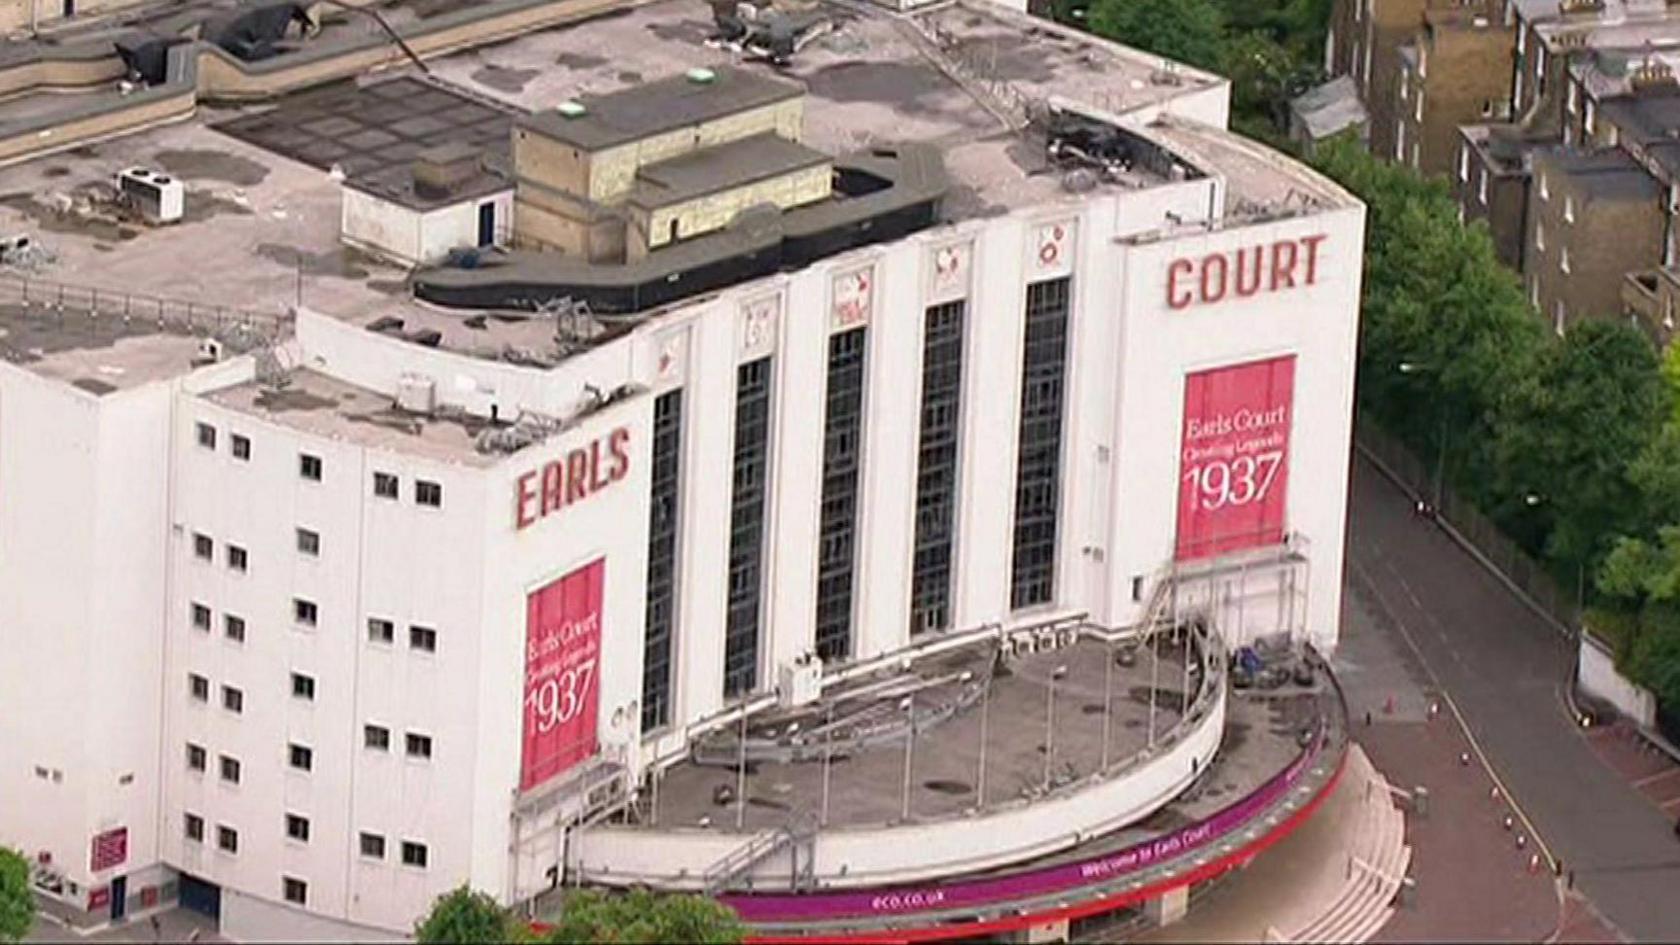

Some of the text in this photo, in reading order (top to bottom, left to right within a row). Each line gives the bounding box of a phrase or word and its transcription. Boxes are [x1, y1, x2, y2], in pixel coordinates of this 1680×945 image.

[1166, 234, 1327, 310] COURT
[1184, 406, 1284, 440] Earls Court
[515, 427, 629, 530] EARLS
[1183, 450, 1283, 511] 1937
[525, 657, 596, 737] 1937
